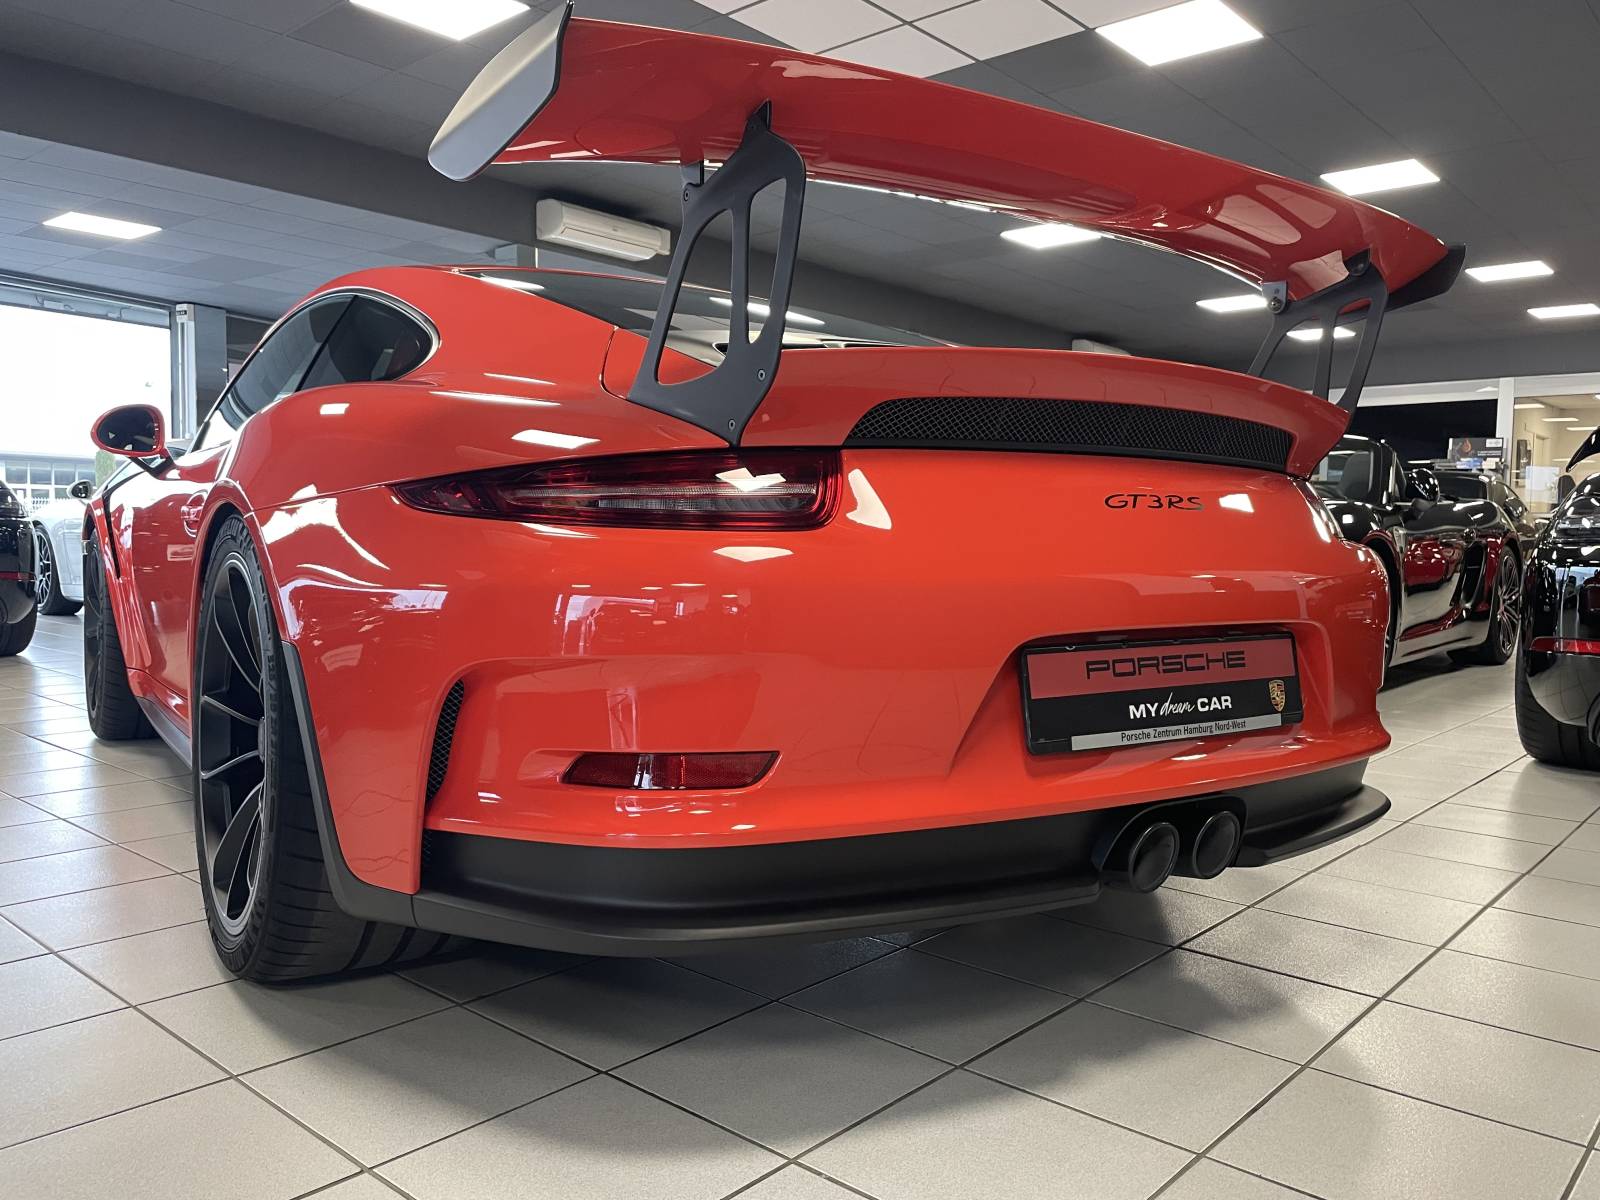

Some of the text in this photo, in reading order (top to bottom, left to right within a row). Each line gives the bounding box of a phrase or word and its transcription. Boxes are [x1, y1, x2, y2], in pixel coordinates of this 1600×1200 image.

[1085, 650, 1246, 680] PORSCHE
[1129, 692, 1233, 720] MY dream CAR
[1121, 719, 1247, 742] Porsche Zentrum Hamburg Nord-West
